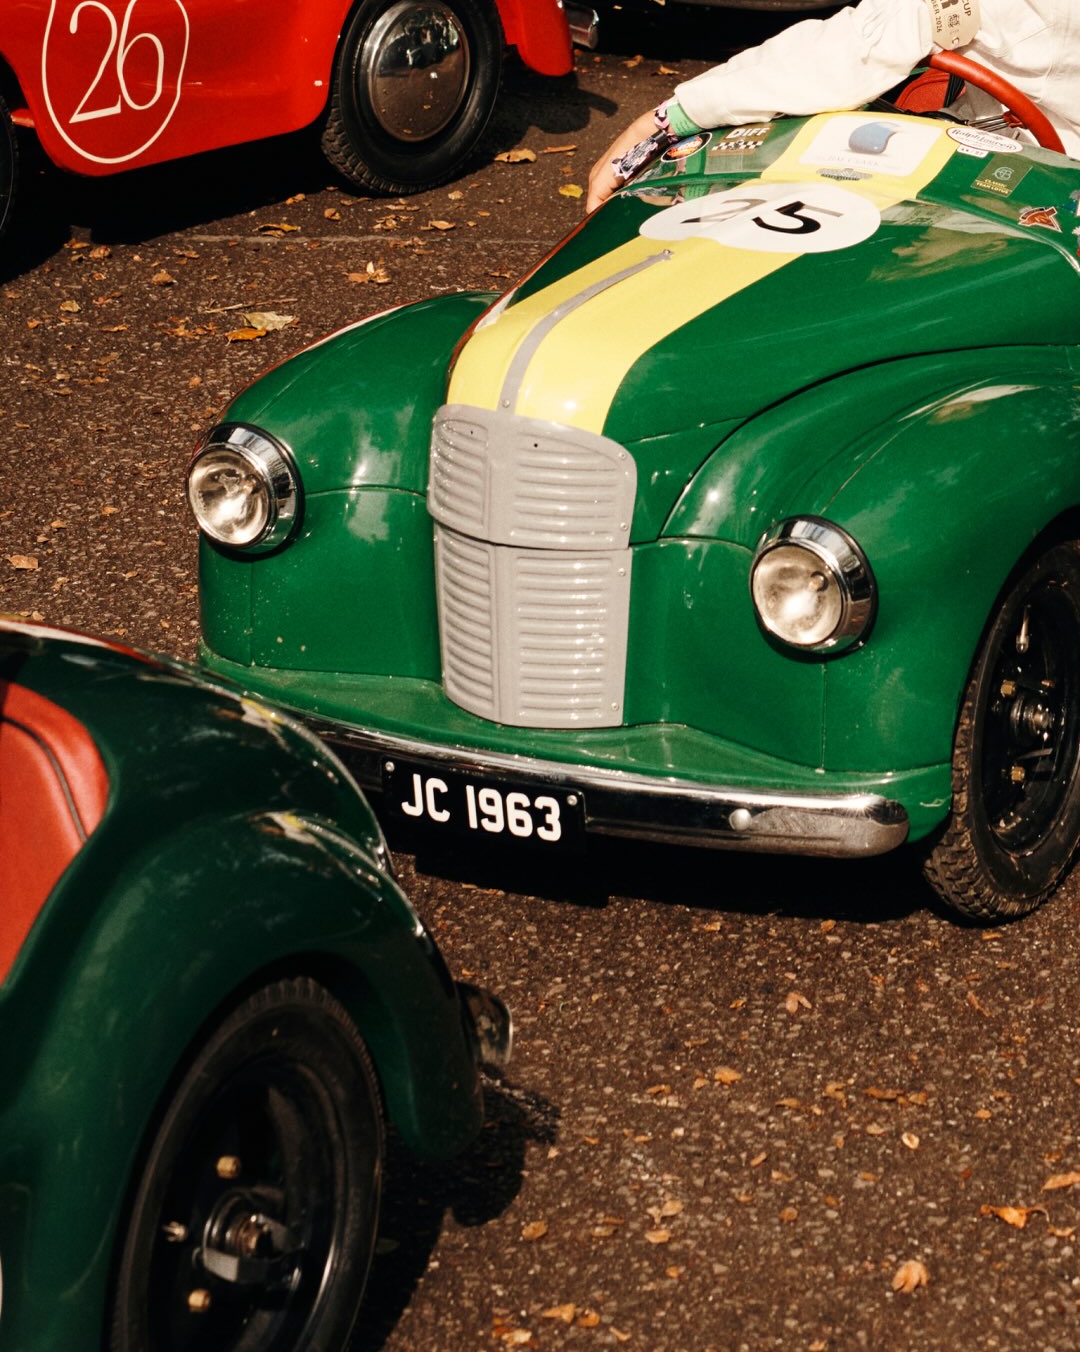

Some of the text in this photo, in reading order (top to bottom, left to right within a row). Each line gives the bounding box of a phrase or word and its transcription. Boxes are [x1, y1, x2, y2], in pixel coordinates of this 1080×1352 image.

[726, 128, 770, 139] DIFF
[681, 199, 844, 235] 25
[401, 773, 562, 842] JC 1963
